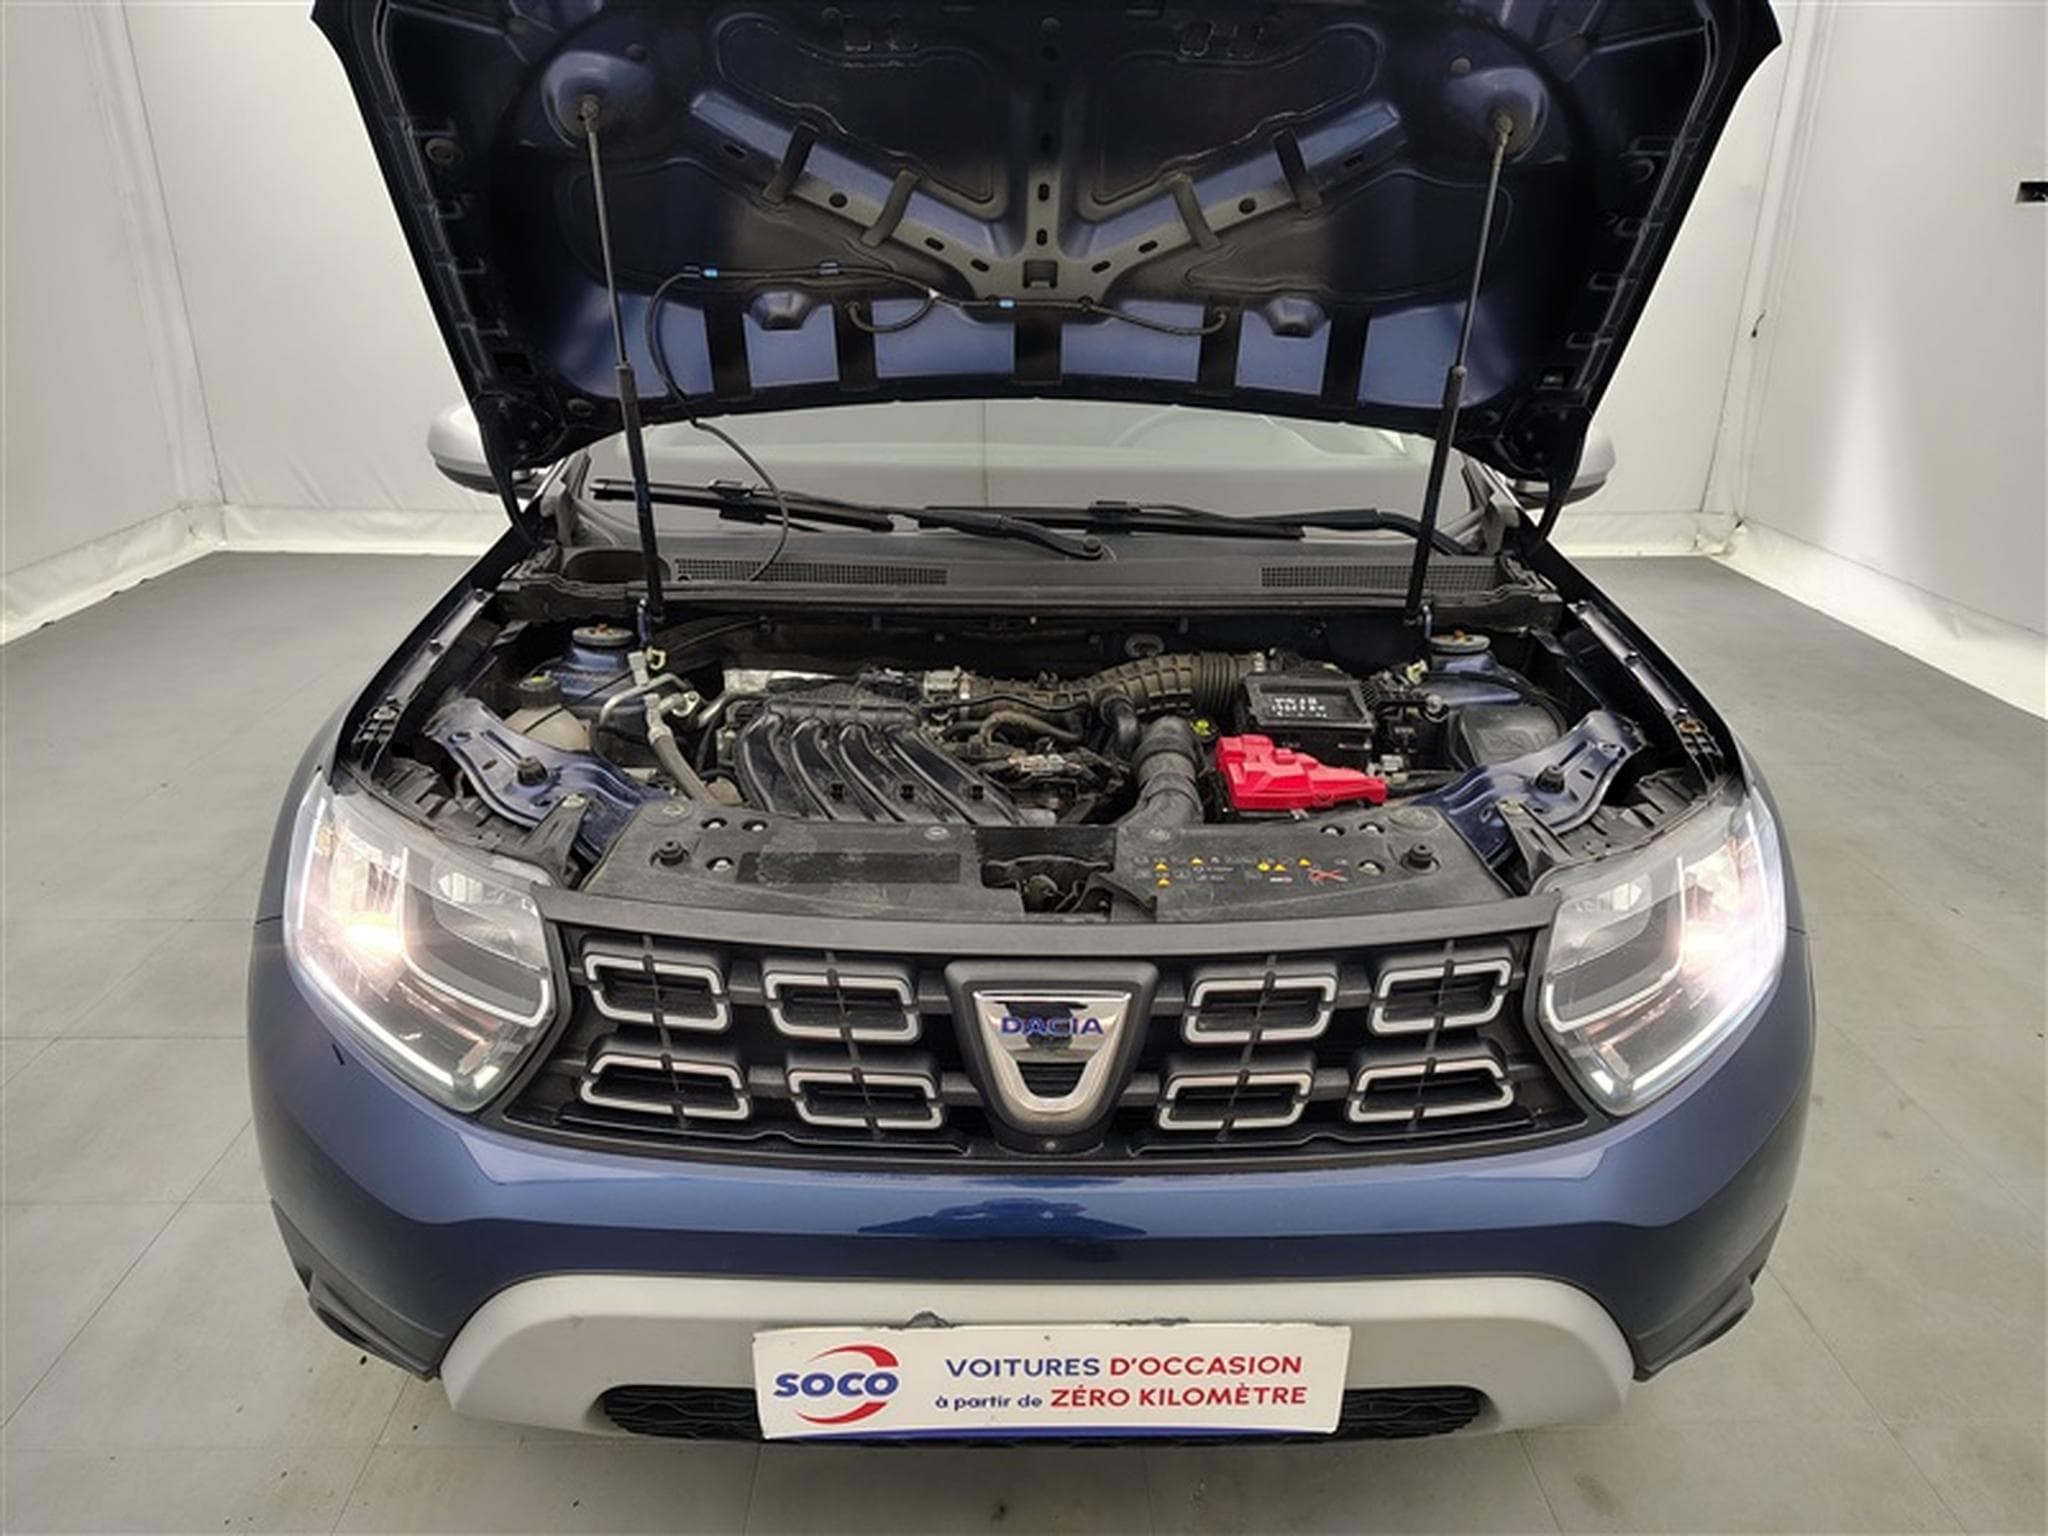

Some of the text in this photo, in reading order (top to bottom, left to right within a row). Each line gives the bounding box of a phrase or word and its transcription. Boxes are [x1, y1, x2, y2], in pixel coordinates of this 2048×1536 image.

[1001, 1016, 1104, 1036] DACIA
[945, 1356, 1302, 1377] VOITURES D'OCCASION
[773, 1372, 899, 1397] SOCO
[935, 1382, 1308, 1411] à partir de ZÉRO KILOMÈTRE
